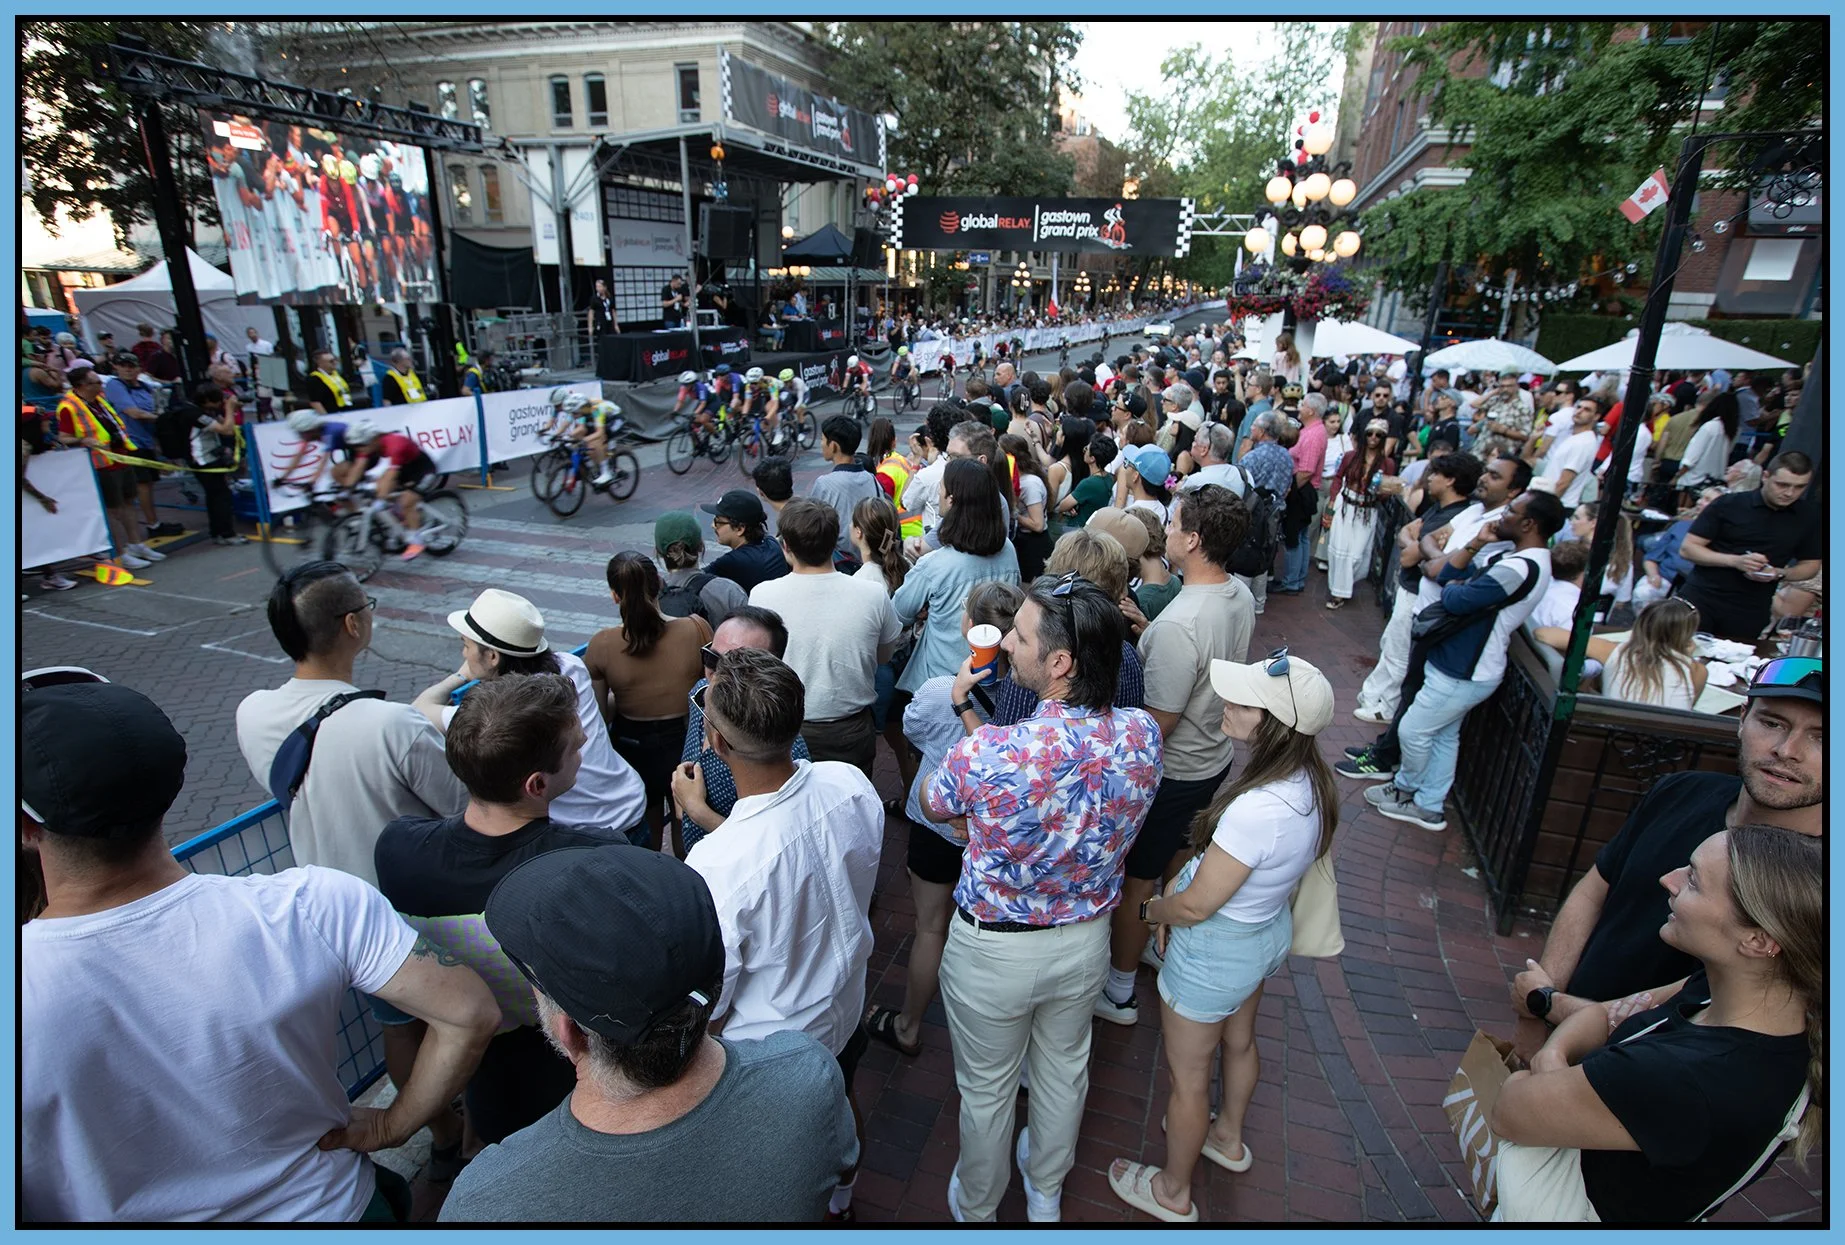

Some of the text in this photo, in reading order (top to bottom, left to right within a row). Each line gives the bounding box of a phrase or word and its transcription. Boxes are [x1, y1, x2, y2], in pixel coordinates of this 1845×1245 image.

[1040, 210, 1090, 225] gastown
[1040, 223, 1099, 239] grand prix
[803, 365, 826, 380] gastown
[509, 404, 552, 425] gastown
[510, 419, 540, 443] grand
